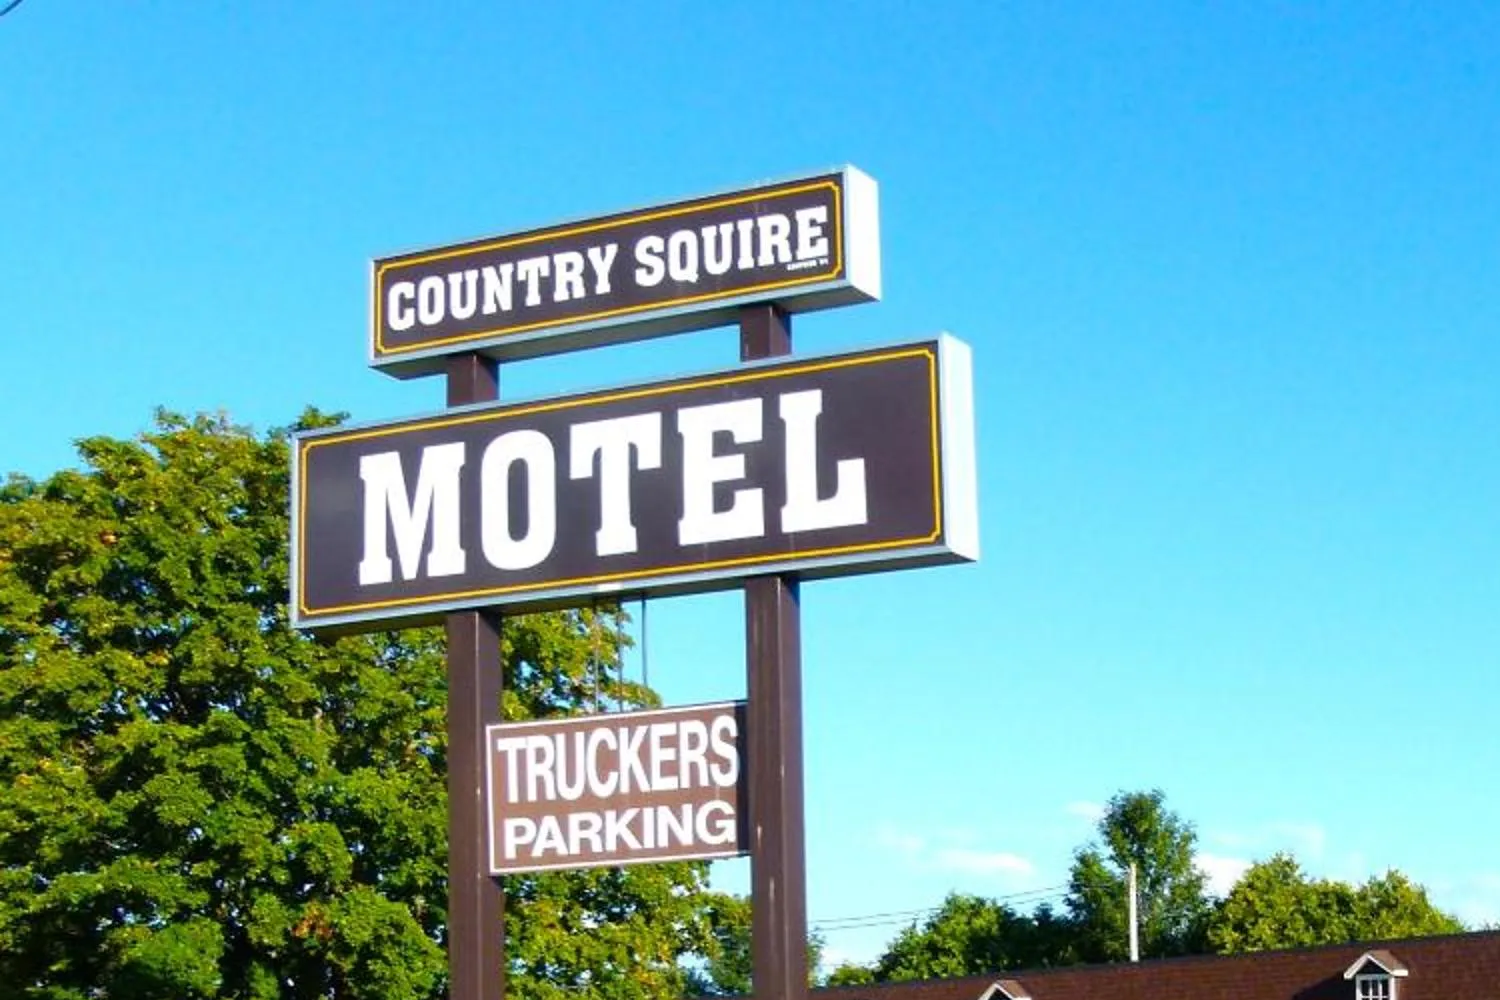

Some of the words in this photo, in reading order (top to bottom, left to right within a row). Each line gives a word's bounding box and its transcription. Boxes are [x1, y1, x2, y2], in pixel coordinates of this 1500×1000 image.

[388, 243, 618, 332] COUNTRY
[634, 205, 829, 287] SQUIRE
[358, 389, 868, 585] MOTEL
[496, 714, 739, 803] TRUCKERS
[503, 800, 736, 859] PARKING
